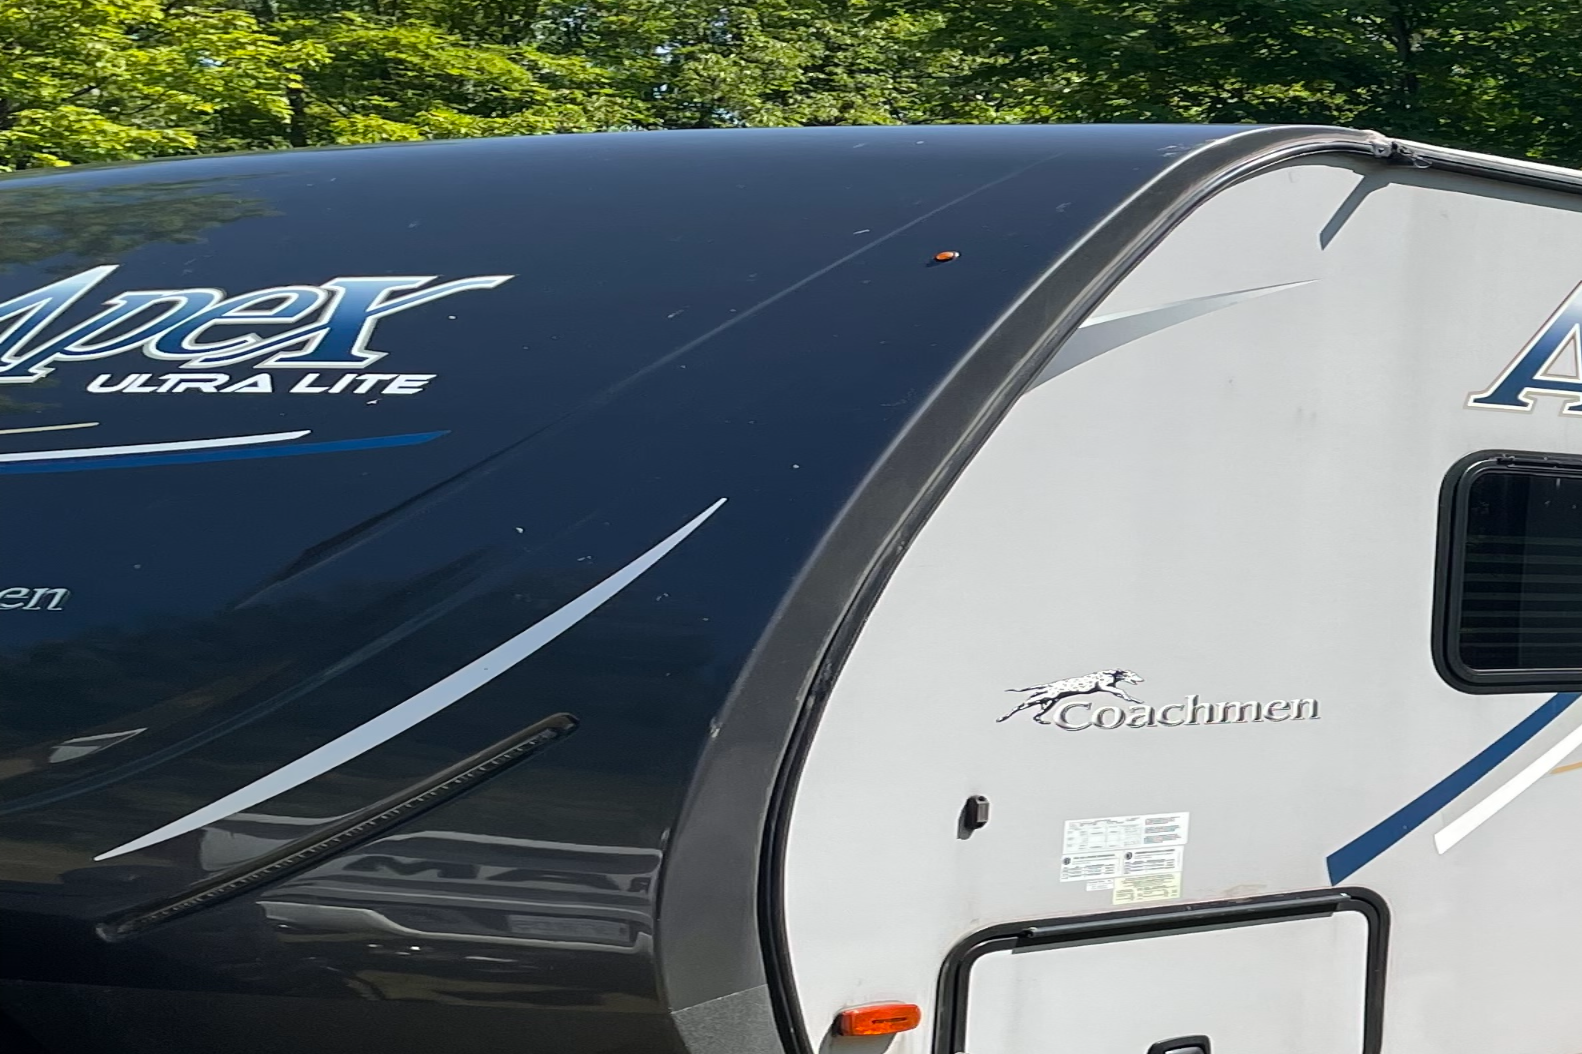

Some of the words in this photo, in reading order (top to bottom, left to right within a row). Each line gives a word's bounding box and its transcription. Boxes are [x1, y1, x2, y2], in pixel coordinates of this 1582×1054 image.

[86, 372, 274, 394] ULTRA
[288, 373, 438, 395] LITE
[1053, 695, 1322, 731] Coachmen
